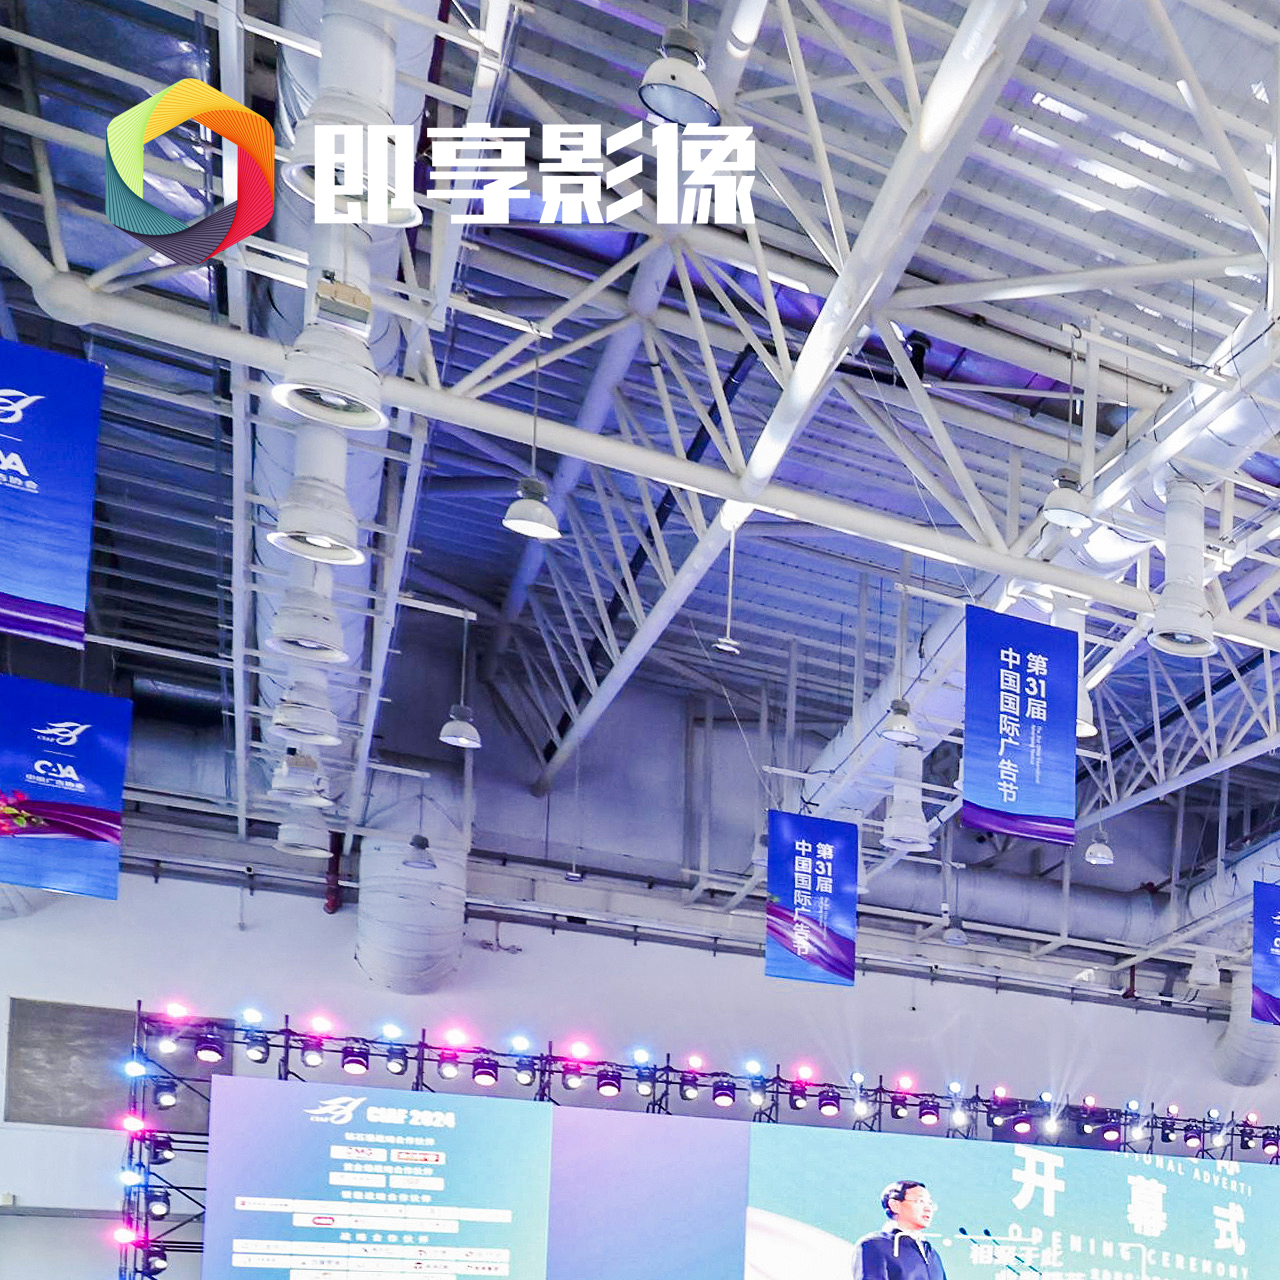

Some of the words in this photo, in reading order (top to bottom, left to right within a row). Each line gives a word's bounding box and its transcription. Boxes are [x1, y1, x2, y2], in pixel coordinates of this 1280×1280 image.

[997, 647, 1021, 803] 中国国际广告节
[1024, 652, 1049, 722] 第31届
[792, 839, 812, 956] 中国国际广告节
[814, 841, 835, 894] 第31届
